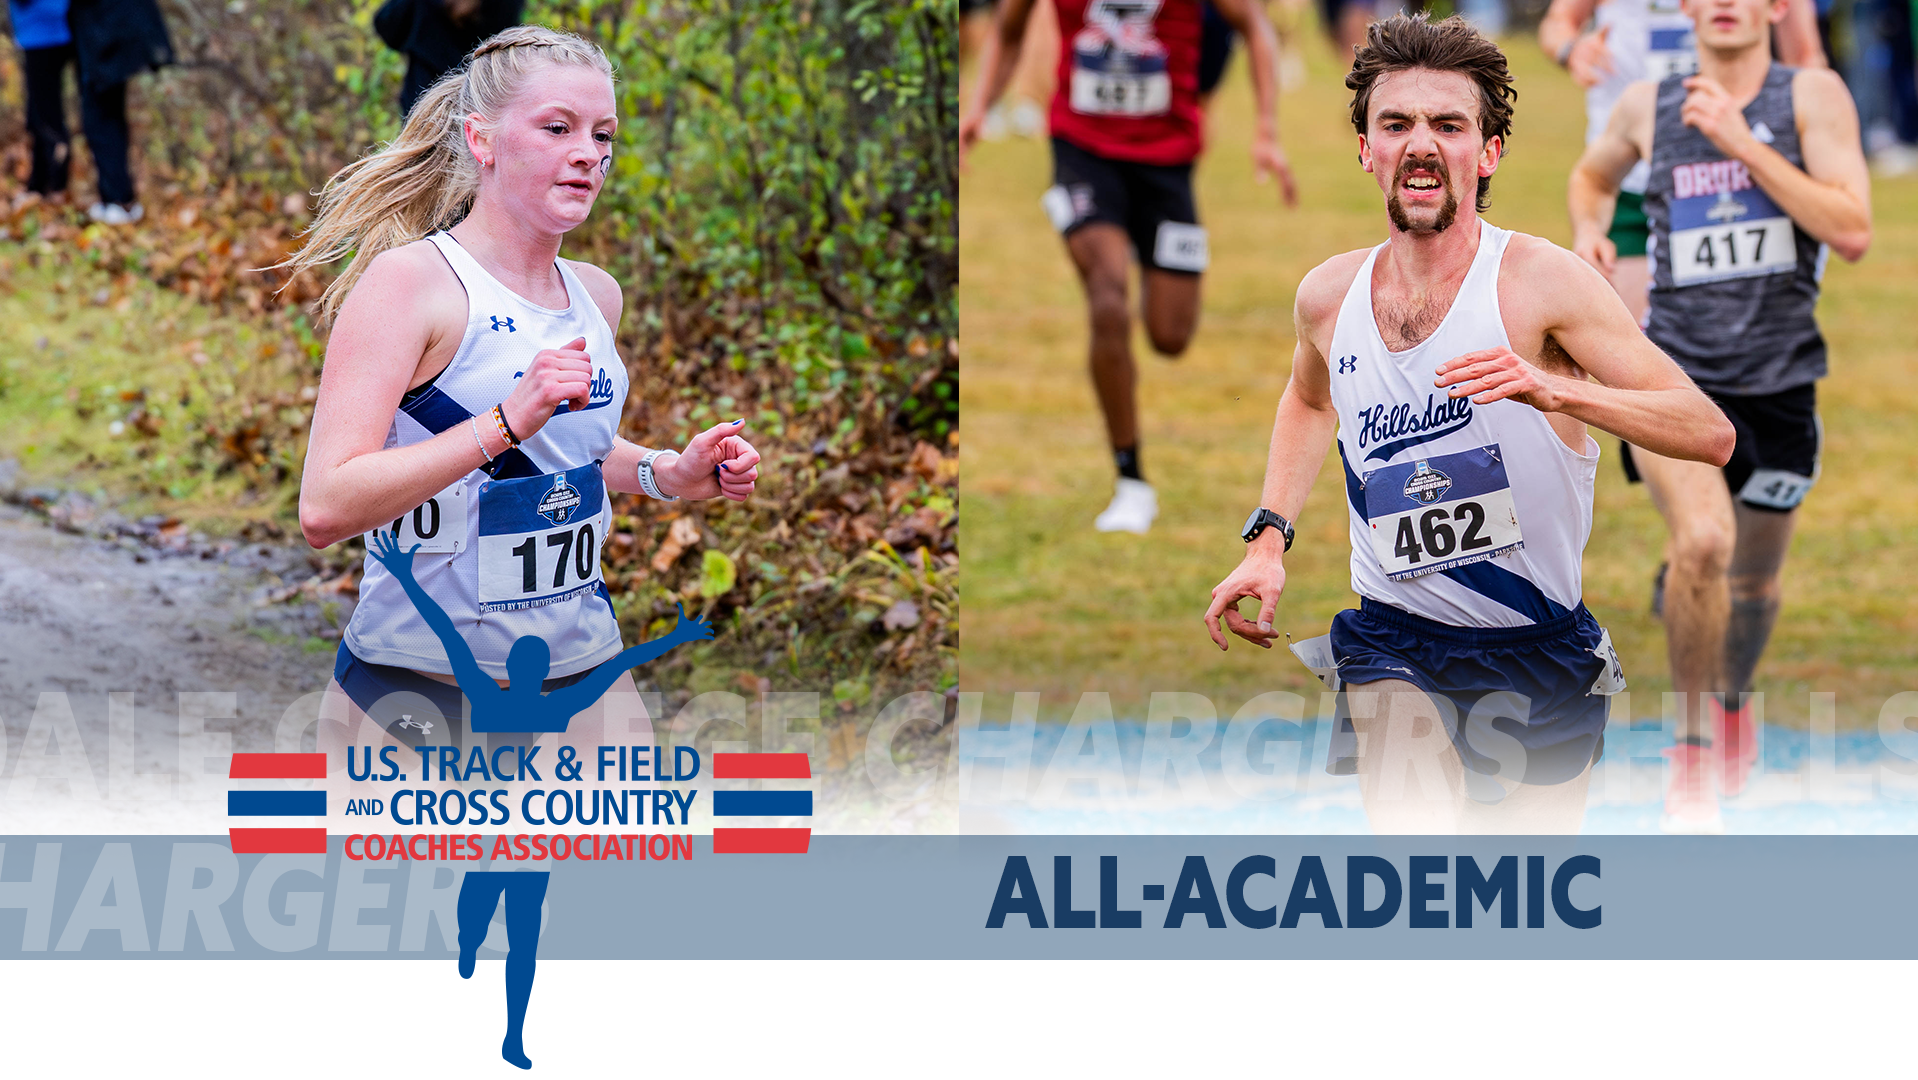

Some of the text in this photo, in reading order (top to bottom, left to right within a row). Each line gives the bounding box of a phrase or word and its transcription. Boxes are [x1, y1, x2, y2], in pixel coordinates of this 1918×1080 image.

[1695, 228, 1767, 267] 417
[1358, 386, 1473, 449] Hillsdale
[1405, 479, 1450, 494] CHAMPIONSHIPS
[539, 496, 580, 512] CHAMPIONSHIPS
[1395, 503, 1492, 563] 462
[513, 524, 594, 592] 170
[1402, 571, 1413, 579] THE
[1413, 562, 1448, 578] UNIVERSITY
[1448, 560, 1456, 569] OF
[1457, 553, 1491, 567] WISCONSIN
[507, 602, 516, 611] BY
[517, 600, 530, 609] THE
[530, 595, 563, 608] UNIVERSITY
[564, 593, 571, 601] OF
